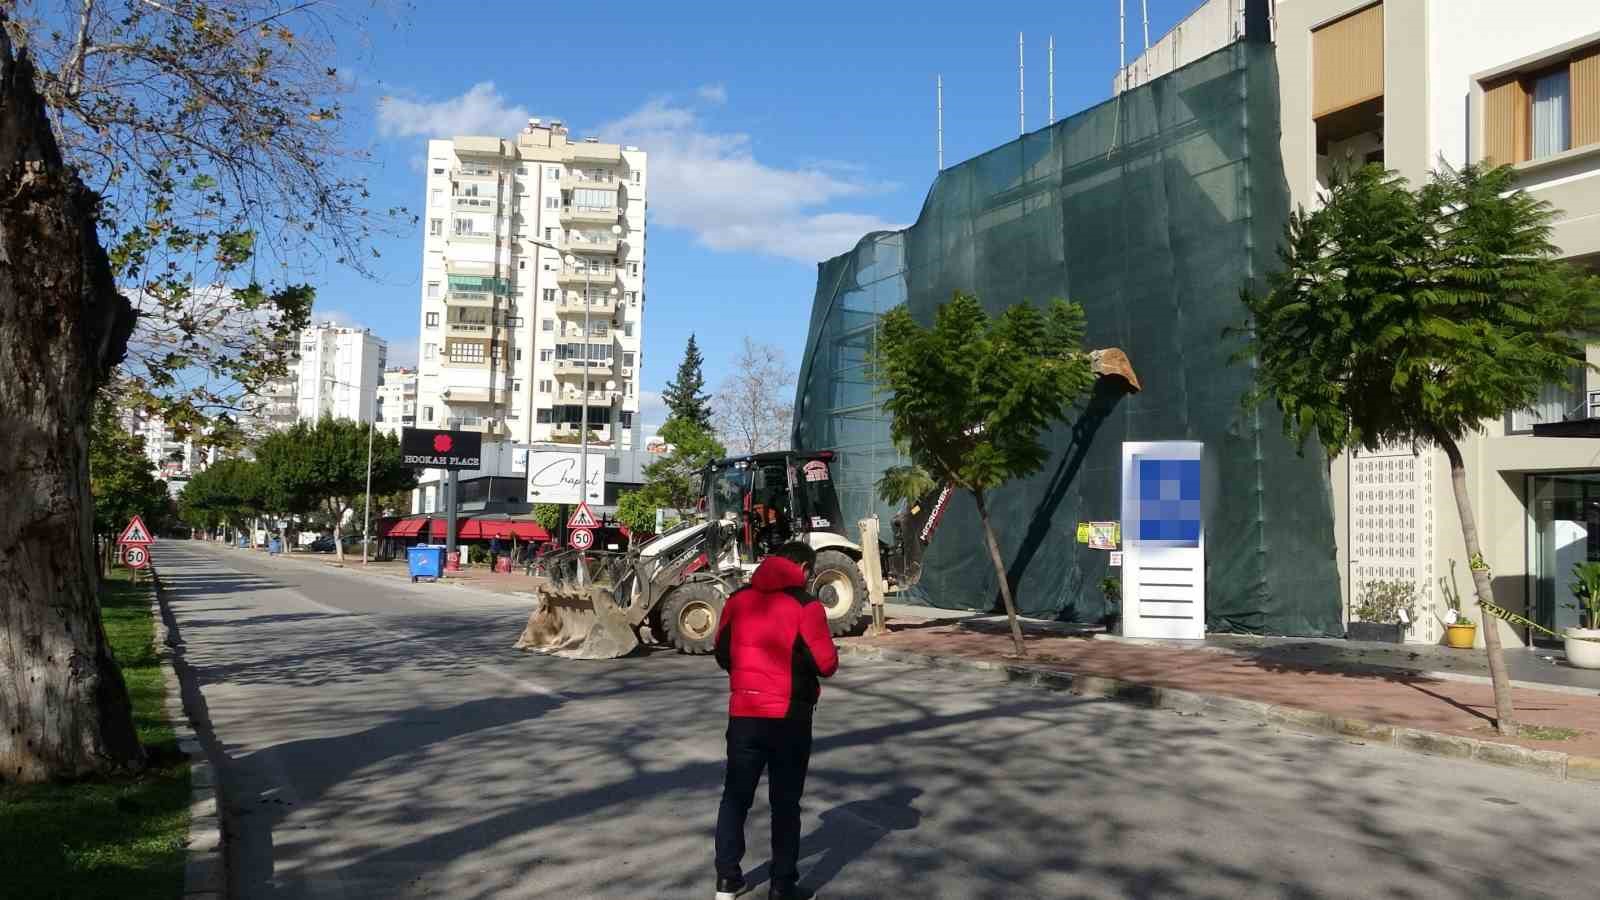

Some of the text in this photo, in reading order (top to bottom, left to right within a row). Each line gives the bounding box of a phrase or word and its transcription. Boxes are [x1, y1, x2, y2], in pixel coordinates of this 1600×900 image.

[404, 455, 479, 466] HOOKAH PLACE
[575, 533, 589, 544] 50
[128, 550, 144, 562] 50
